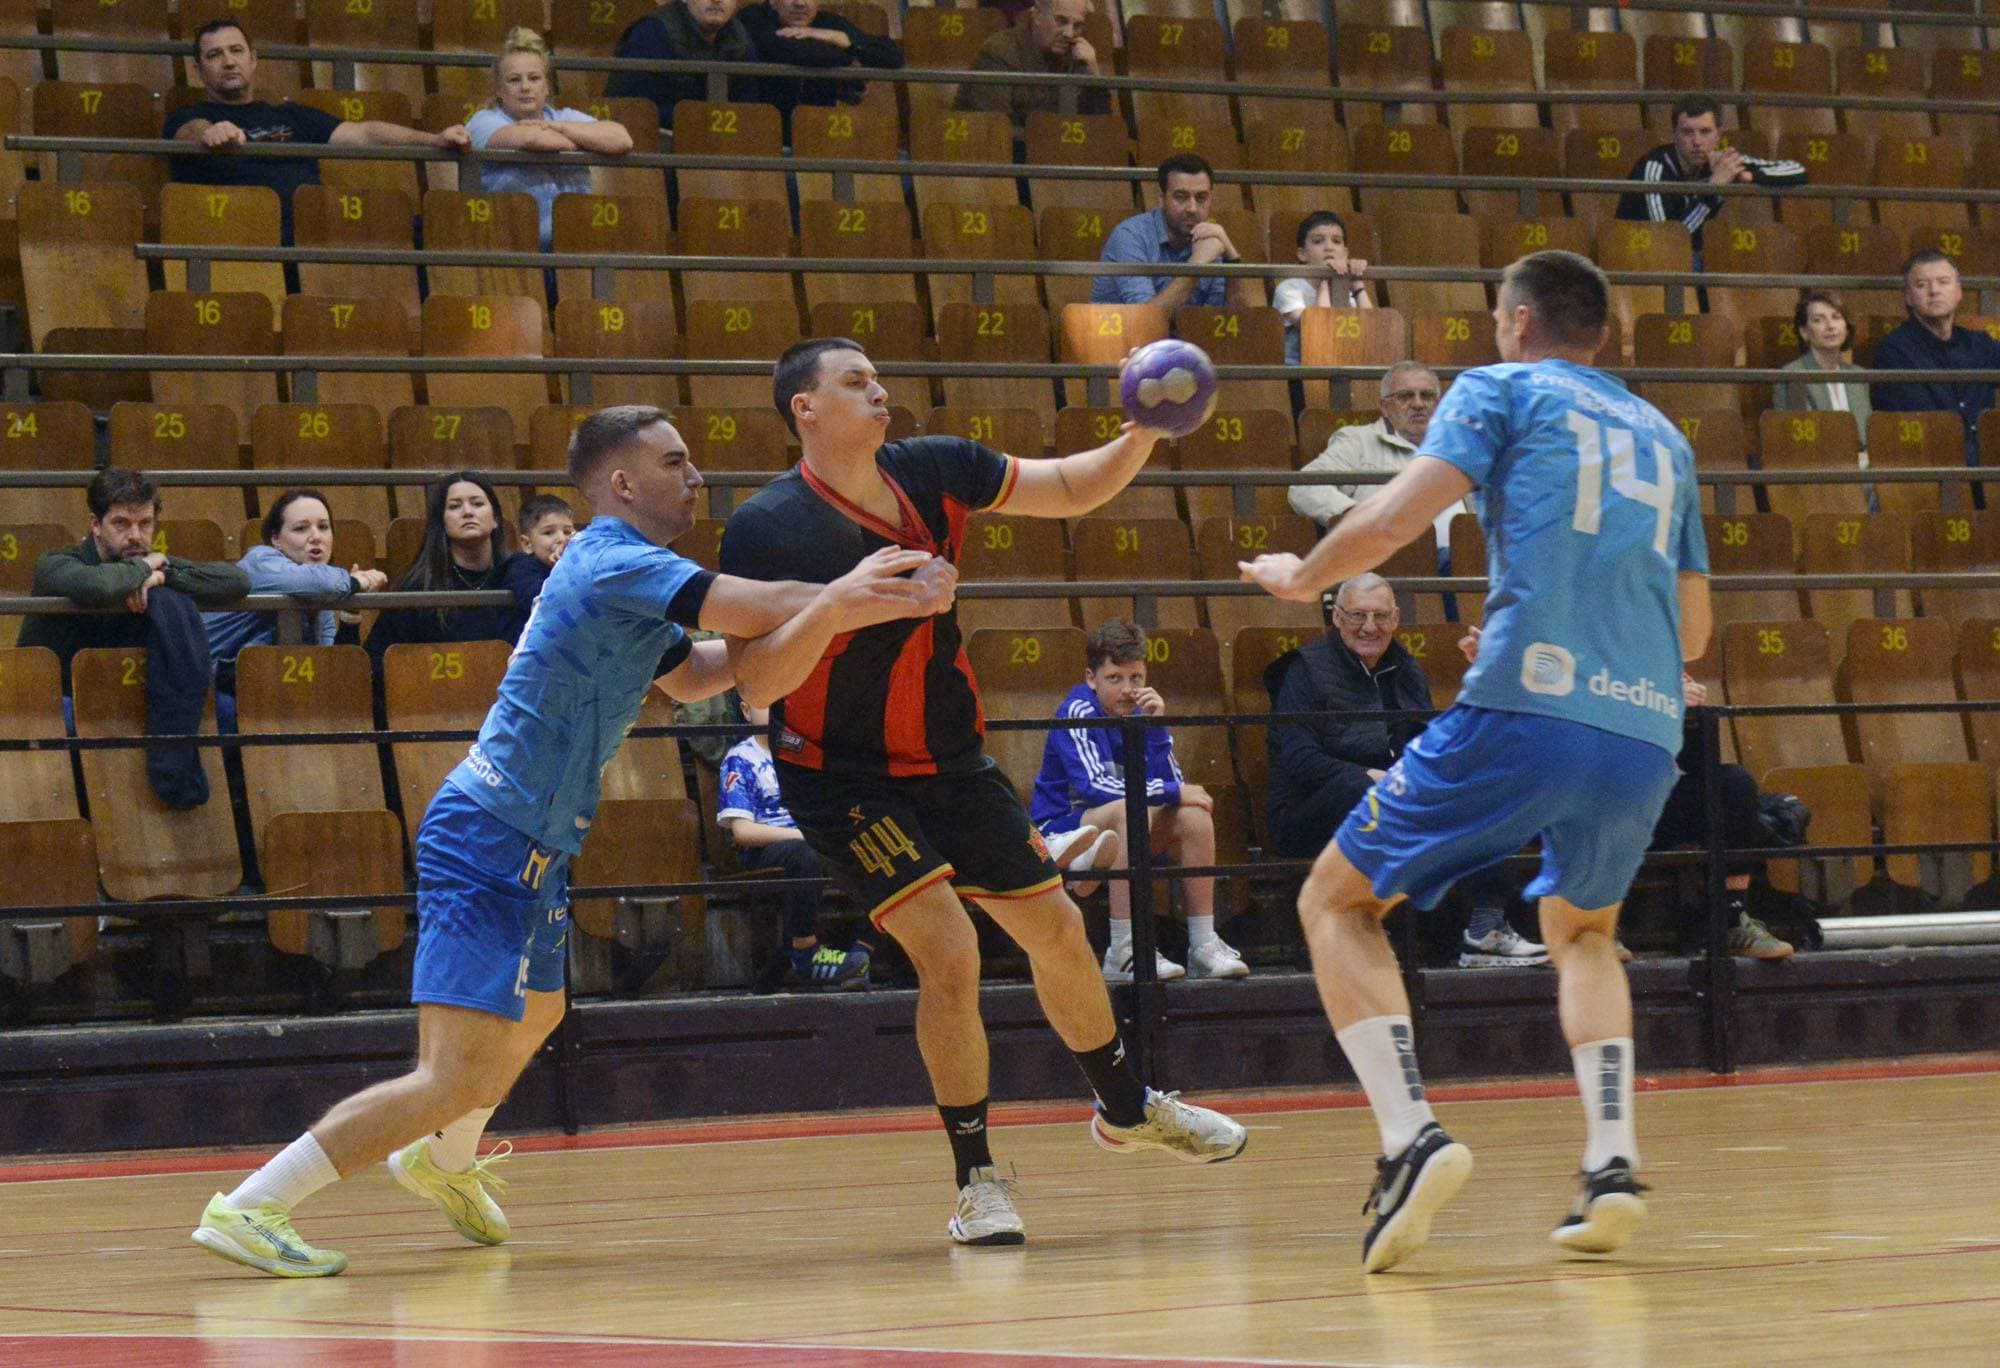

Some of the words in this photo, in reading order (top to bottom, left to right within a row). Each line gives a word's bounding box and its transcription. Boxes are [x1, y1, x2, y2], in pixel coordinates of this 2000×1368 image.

[590, 2, 616, 25] 22
[938, 14, 965, 38] 25
[1159, 22, 1185, 46] 27
[80, 90, 104, 114] 17
[340, 99, 365, 122] 19
[710, 110, 738, 134] 22
[827, 114, 853, 139] 23
[944, 118, 969, 142] 24
[1060, 121, 1087, 145] 25
[1387, 130, 1413, 152] 28
[1494, 133, 1520, 157] 29
[1597, 136, 1622, 160] 30
[65, 190, 91, 216] 16
[206, 193, 230, 218] 17
[466, 198, 492, 224] 19
[591, 202, 620, 228] 20
[718, 205, 741, 231] 21
[837, 208, 867, 234] 22
[962, 212, 989, 236] 23
[1076, 215, 1101, 239] 24
[1523, 224, 1549, 247] 28
[195, 300, 222, 326] 16
[330, 304, 356, 329] 17
[467, 304, 493, 331] 18
[599, 306, 625, 332] 19
[723, 307, 752, 333] 20
[851, 309, 876, 335] 21
[976, 311, 1006, 337] 22
[1099, 312, 1124, 337] 23
[1212, 314, 1241, 339] 24
[1334, 315, 1362, 339] 25
[1444, 317, 1471, 341] 26
[6, 411, 38, 439] 24
[153, 411, 188, 439] 25
[299, 412, 330, 439] 26
[431, 414, 463, 441] 27
[707, 415, 738, 441] 29
[968, 415, 994, 440] 31
[1094, 415, 1121, 439] 32
[1215, 417, 1245, 442] 33
[1565, 408, 1677, 561] 14
[152, 529, 169, 555] 4
[983, 525, 1014, 550] 30
[1115, 526, 1139, 551] 31
[1238, 526, 1269, 550] 32
[1722, 522, 1748, 546] 36
[1838, 521, 1863, 546] 37
[1946, 519, 1971, 544] 38
[0, 533, 19, 561] 3
[1010, 636, 1041, 665] 29
[1757, 629, 1786, 656] 35
[1881, 626, 1909, 652] 36
[121, 656, 146, 686] 2
[282, 655, 316, 684] 24
[430, 651, 464, 681] 25
[1587, 667, 1681, 720] dedina
[848, 815, 922, 879] 44
